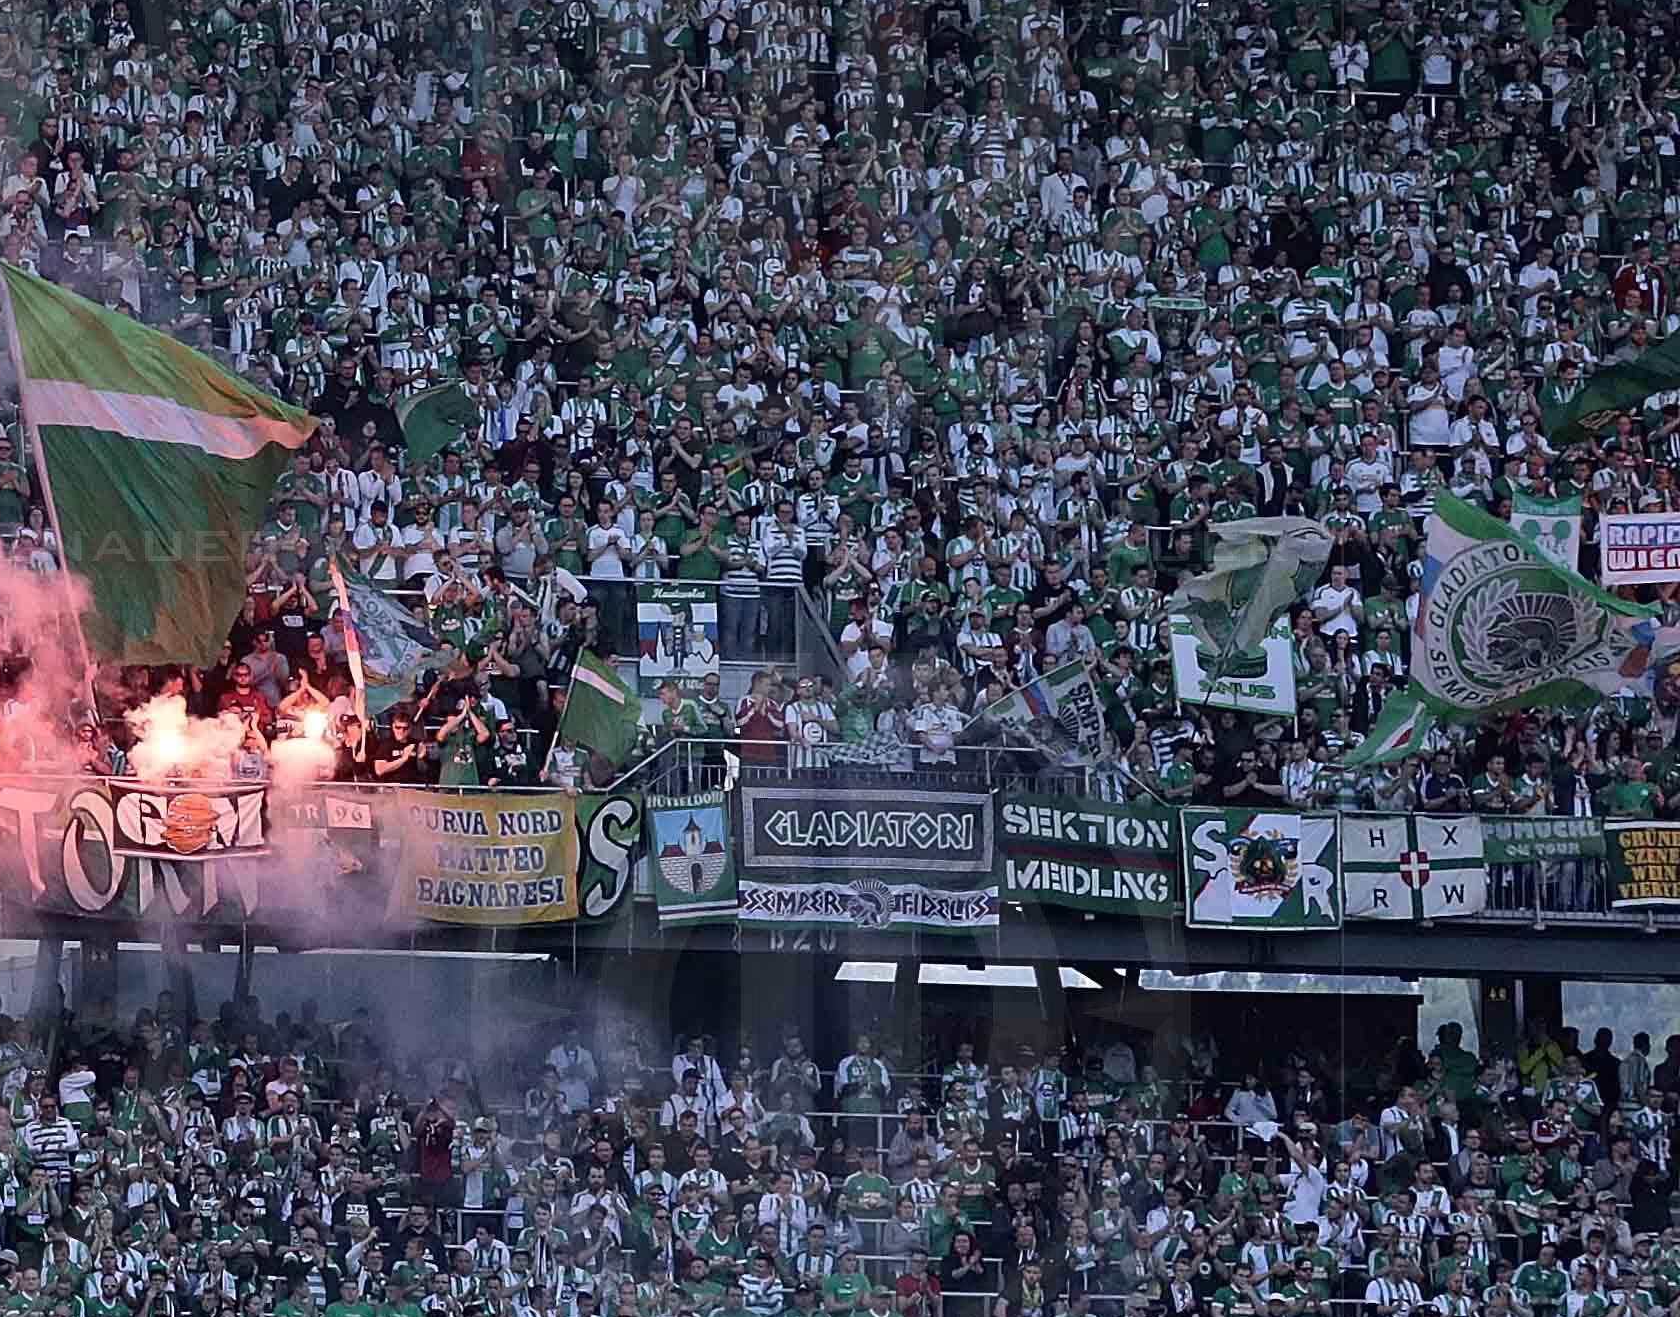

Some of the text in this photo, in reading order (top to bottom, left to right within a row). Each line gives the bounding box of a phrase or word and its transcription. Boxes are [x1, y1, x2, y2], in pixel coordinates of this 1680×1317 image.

[414, 810, 564, 835] CURVA NORD
[764, 809, 975, 852] GLADIATORI
[1001, 803, 1170, 849] SEKTION
[1369, 825, 1458, 848] H X
[437, 845, 545, 874] MATTEO
[417, 878, 566, 909] BAGNARESI
[1005, 859, 1170, 903] MEIDLING
[1373, 884, 1465, 909] R W
[740, 886, 990, 922] SEMPER FIDELIS
